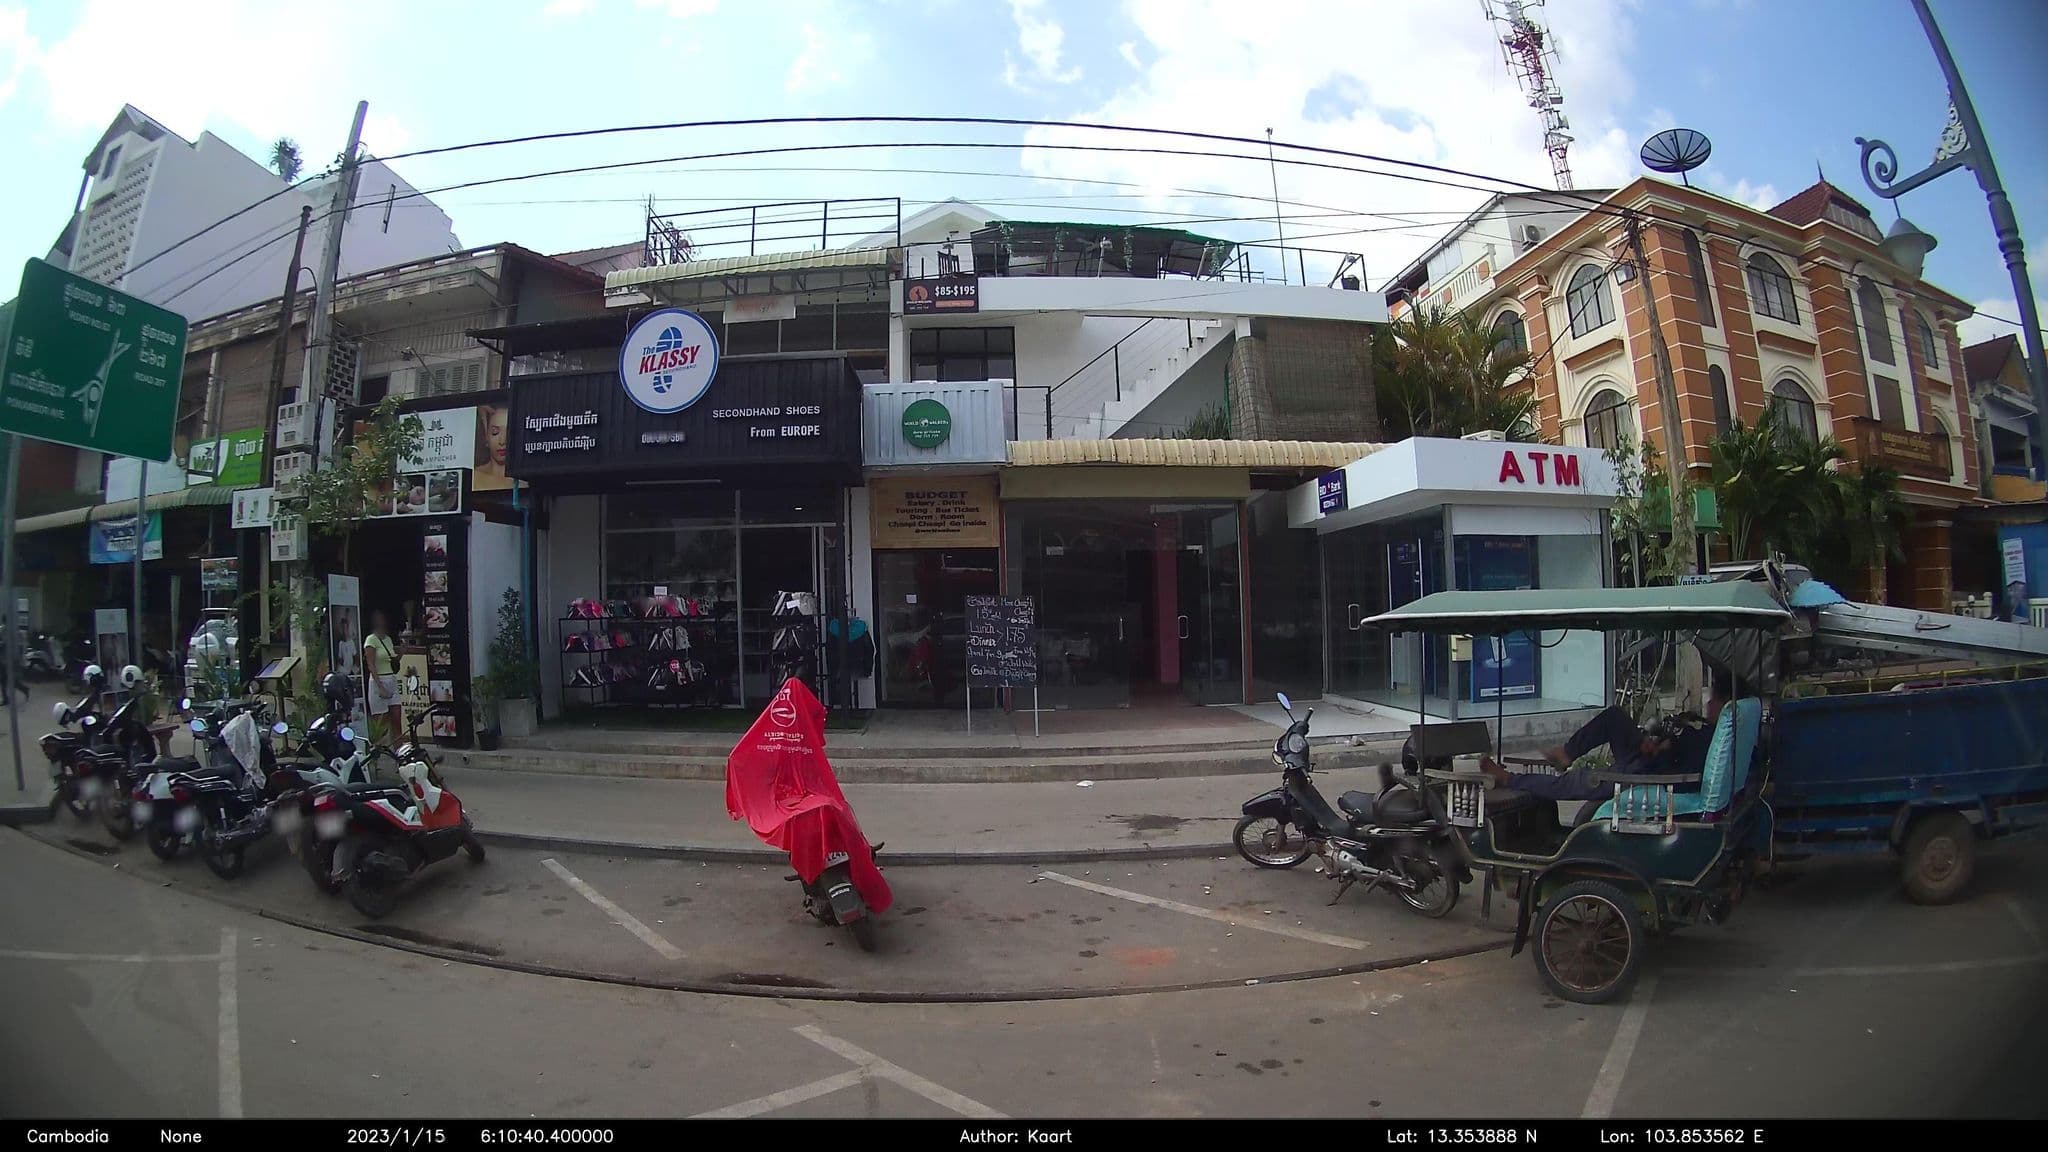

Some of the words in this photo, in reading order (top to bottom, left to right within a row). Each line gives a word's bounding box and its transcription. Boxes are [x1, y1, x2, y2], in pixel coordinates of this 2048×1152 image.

[934, 285, 976, 297] $85-$195
[642, 345, 656, 355] The
[639, 345, 702, 376] KLASSY
[712, 407, 781, 418] SECONDHAND
[785, 405, 821, 415] SHOES
[750, 426, 776, 437] From
[781, 425, 821, 437] EUROPE
[1499, 451, 1580, 487] ATM
[905, 491, 968, 499] BUDGET
[970, 620, 995, 634] Lunch
